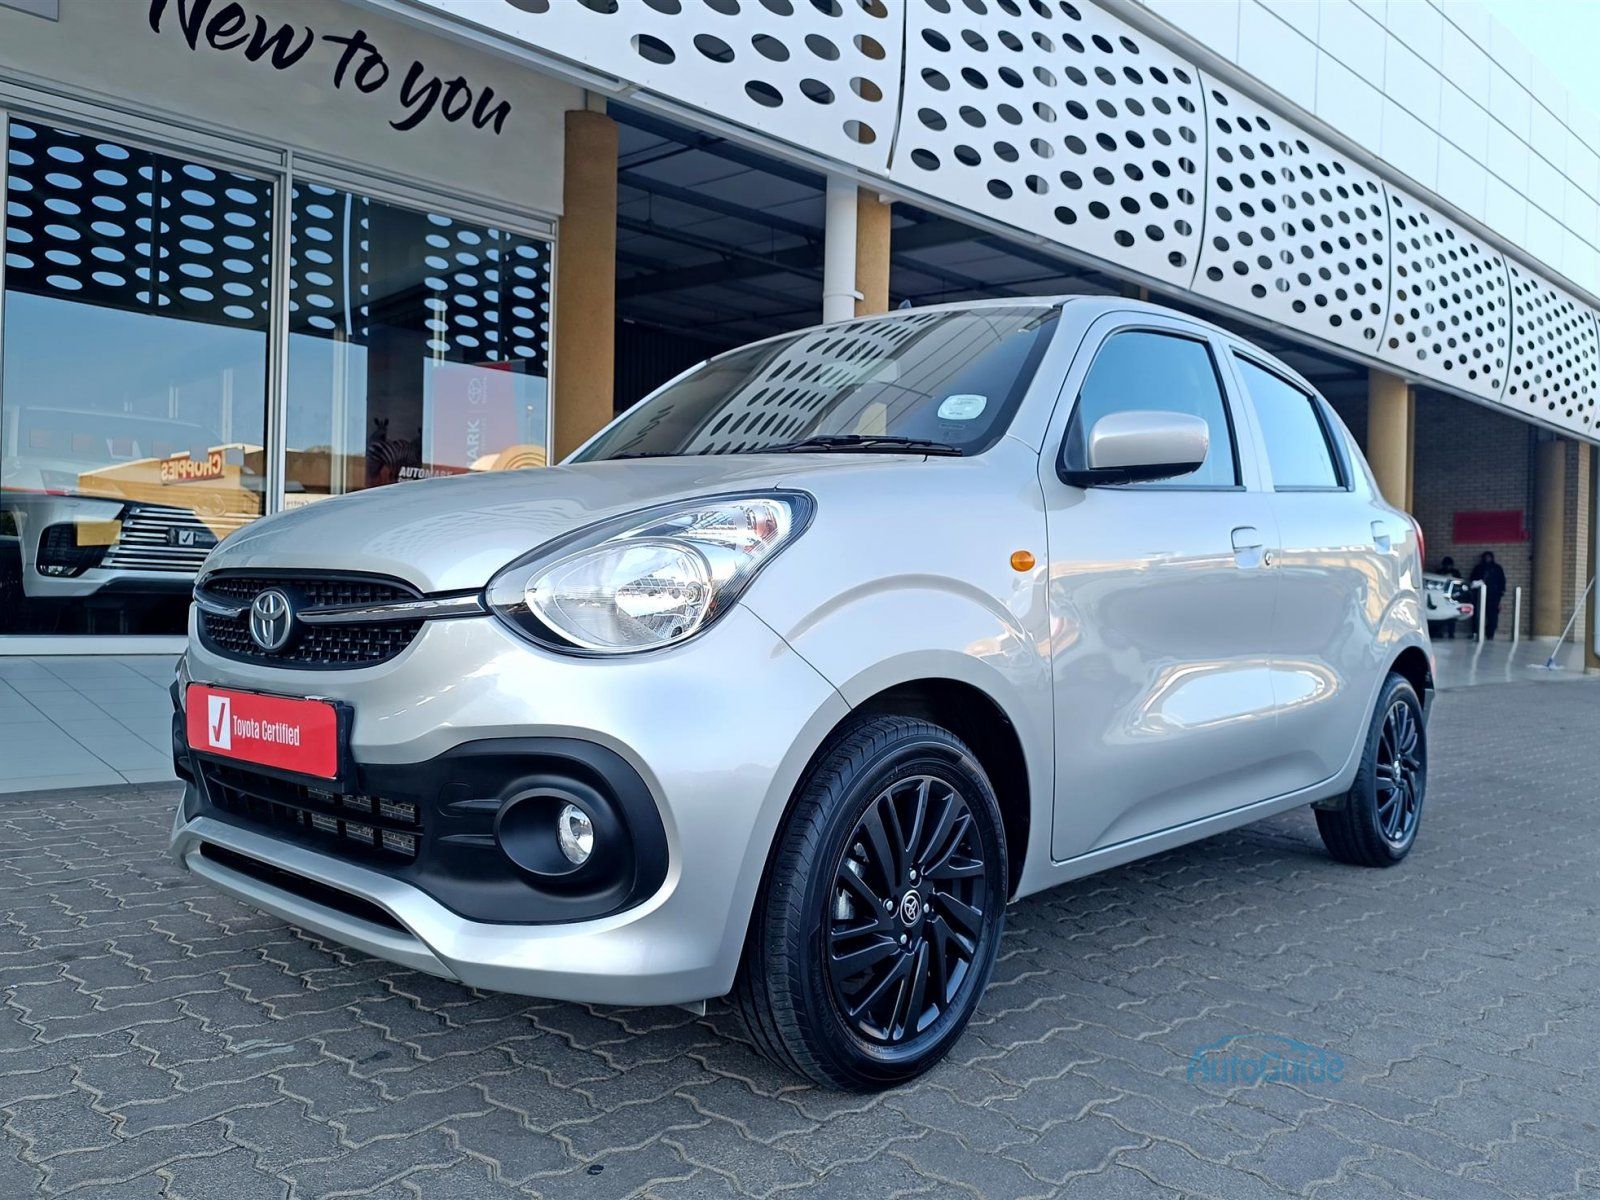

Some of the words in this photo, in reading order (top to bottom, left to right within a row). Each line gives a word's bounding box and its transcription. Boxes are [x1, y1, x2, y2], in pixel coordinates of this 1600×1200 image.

[149, 0, 314, 70] New
[322, 29, 389, 93] to
[389, 60, 511, 135] you
[466, 418, 480, 466] ARK
[233, 714, 260, 740] Toyota
[262, 720, 300, 746] Certified
